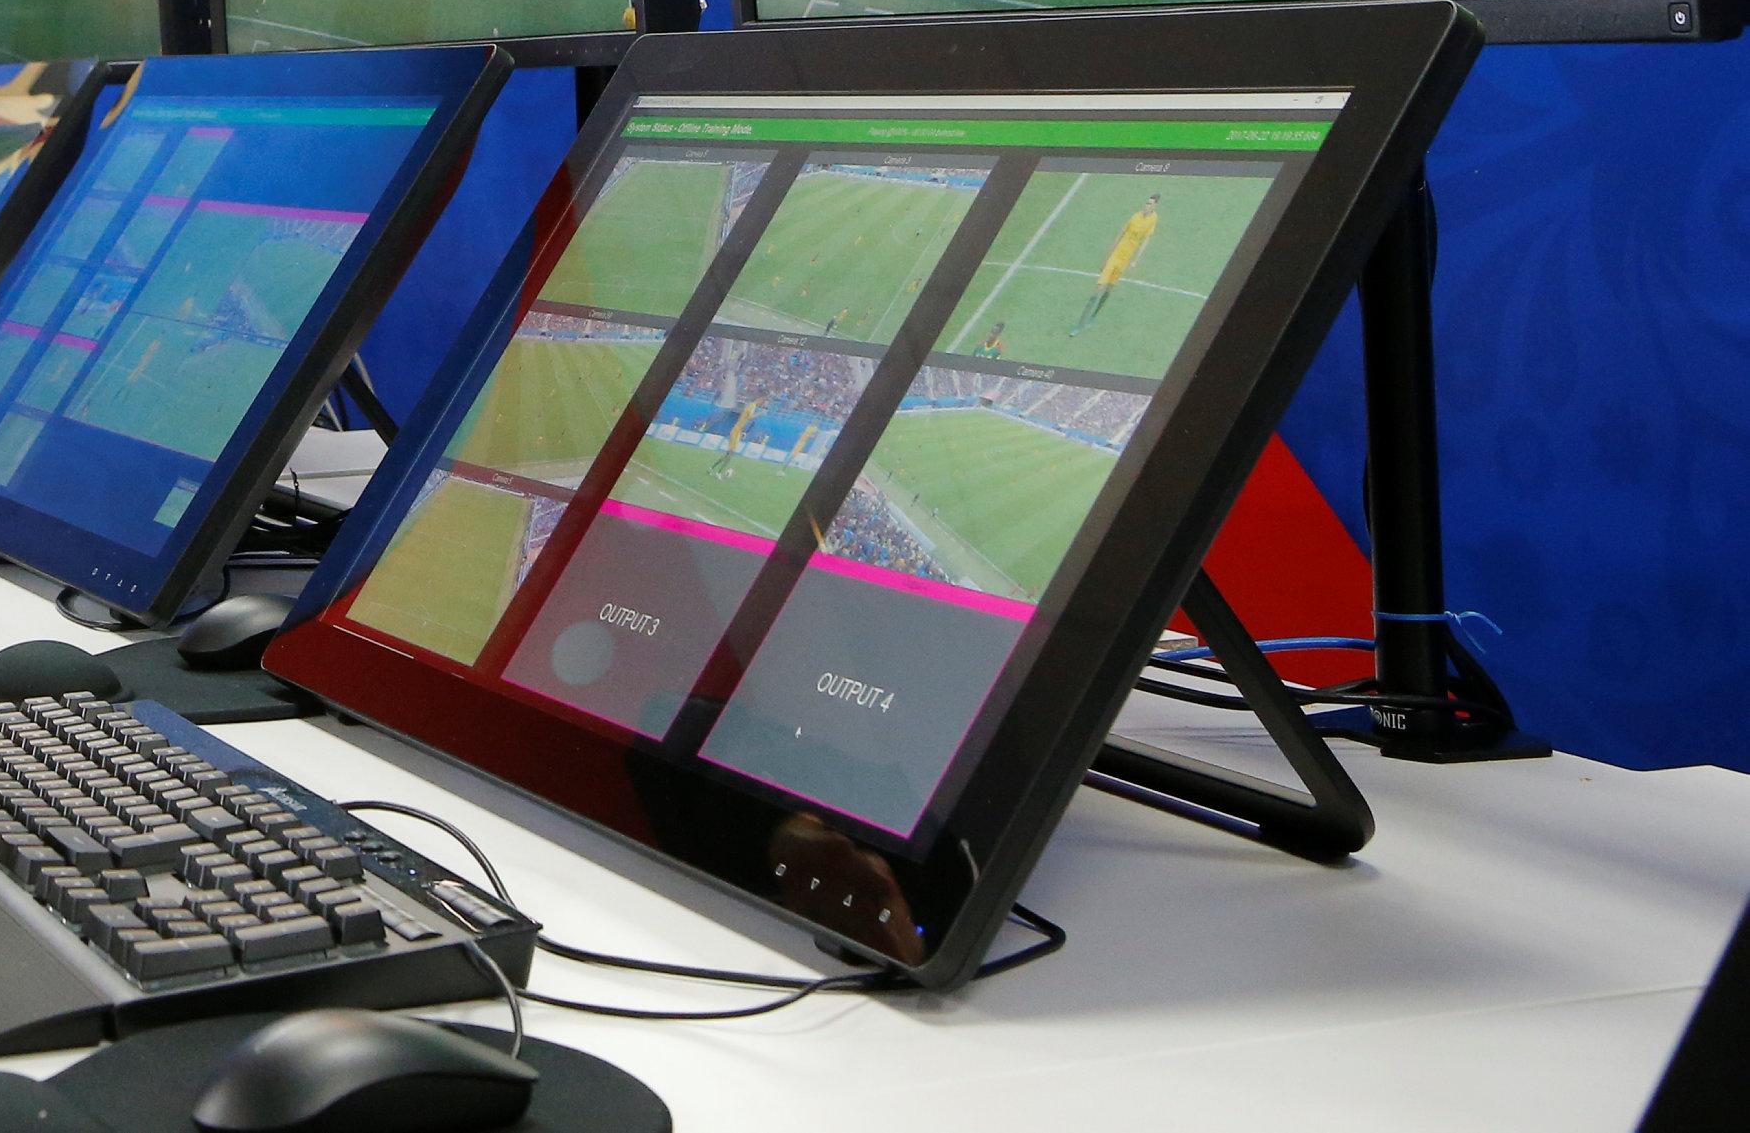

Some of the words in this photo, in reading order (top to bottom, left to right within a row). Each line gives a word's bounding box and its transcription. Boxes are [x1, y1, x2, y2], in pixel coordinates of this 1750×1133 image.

[598, 603, 651, 636] OUTPUT
[646, 618, 660, 637] 3
[816, 672, 885, 710] OUTPUT
[880, 693, 895, 713] 4
